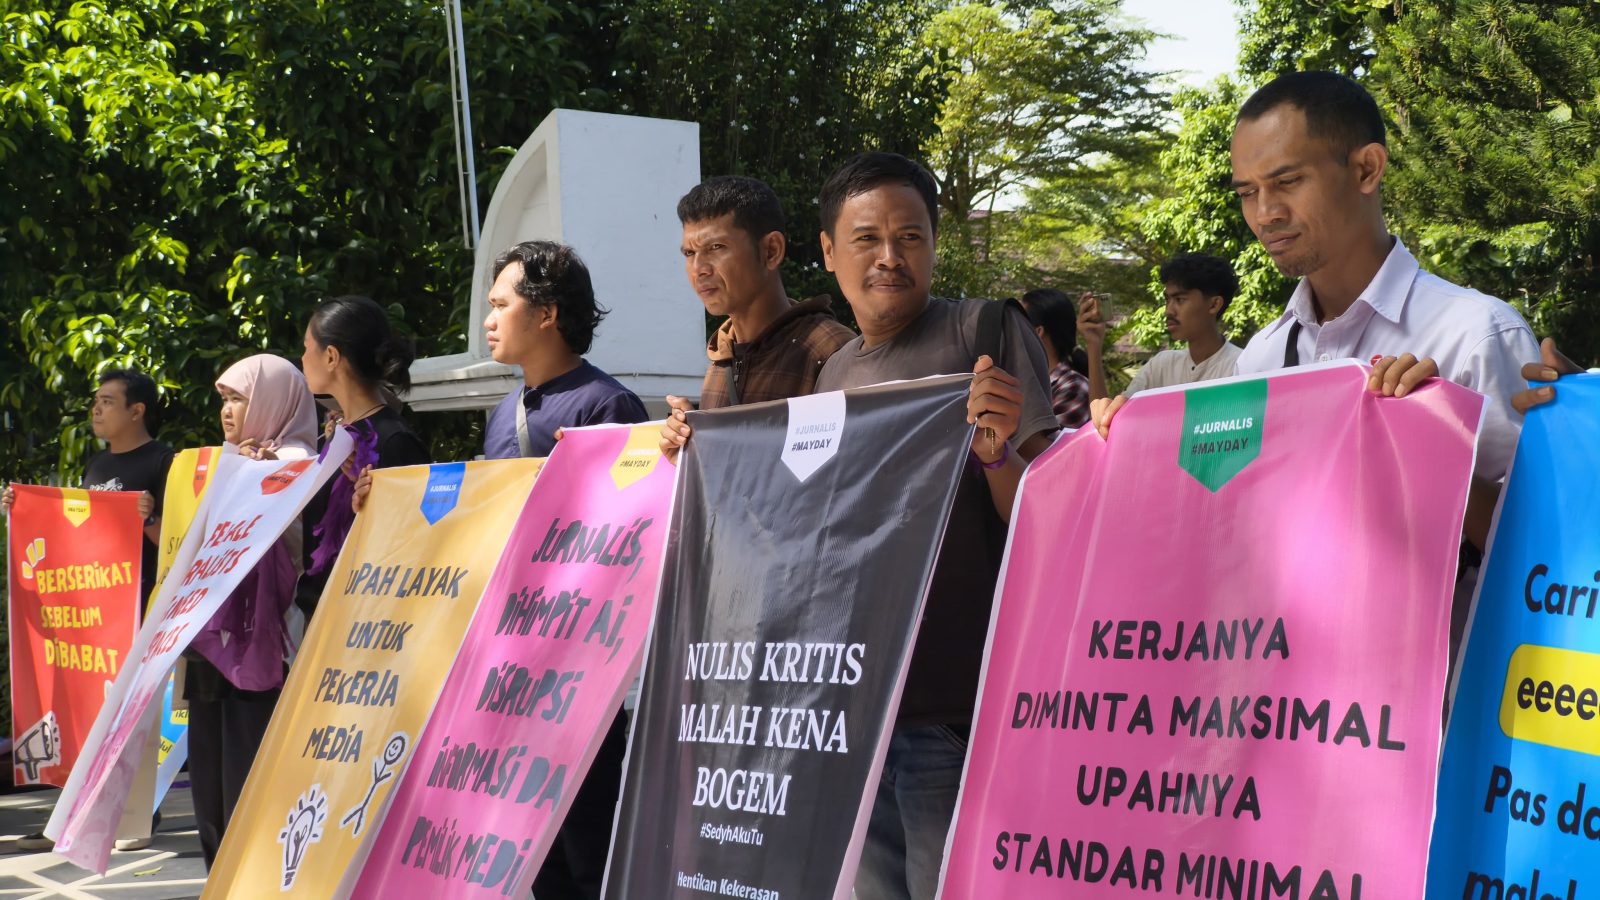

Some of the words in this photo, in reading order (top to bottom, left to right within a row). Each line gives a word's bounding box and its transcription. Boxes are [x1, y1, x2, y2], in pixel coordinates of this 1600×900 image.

[791, 438, 832, 452] #MAYDAY
[795, 422, 837, 436] #JURNALIS
[1191, 437, 1249, 456] #MAYDAY
[1193, 417, 1253, 435] #JURNALIS
[619, 460, 650, 468] #MAYDAY
[344, 562, 401, 596] UPAH
[394, 565, 469, 599] LAYAK
[1524, 563, 1600, 619] Cari
[41, 605, 102, 628] SEBELUM
[346, 619, 413, 652] UNTUK
[1088, 616, 1290, 662] KERJANYA
[684, 640, 757, 683] NULIS
[759, 642, 866, 686] KRITIS
[313, 667, 400, 708] PEKERJA
[1517, 677, 1600, 721] eeee
[677, 702, 762, 748] MALAH
[764, 708, 849, 754] KENA
[1011, 691, 1154, 735] DIMINTA
[1168, 695, 1406, 752] MAKSIMAL
[692, 766, 792, 817] BOGEM
[1076, 764, 1262, 822] UPAHNYA
[1483, 764, 1549, 827] Pas
[700, 823, 764, 846] #SedyhAkuTu
[992, 831, 1166, 893] STANDAR
[677, 871, 717, 893] Hentikan
[719, 878, 780, 900] Kekerasan
